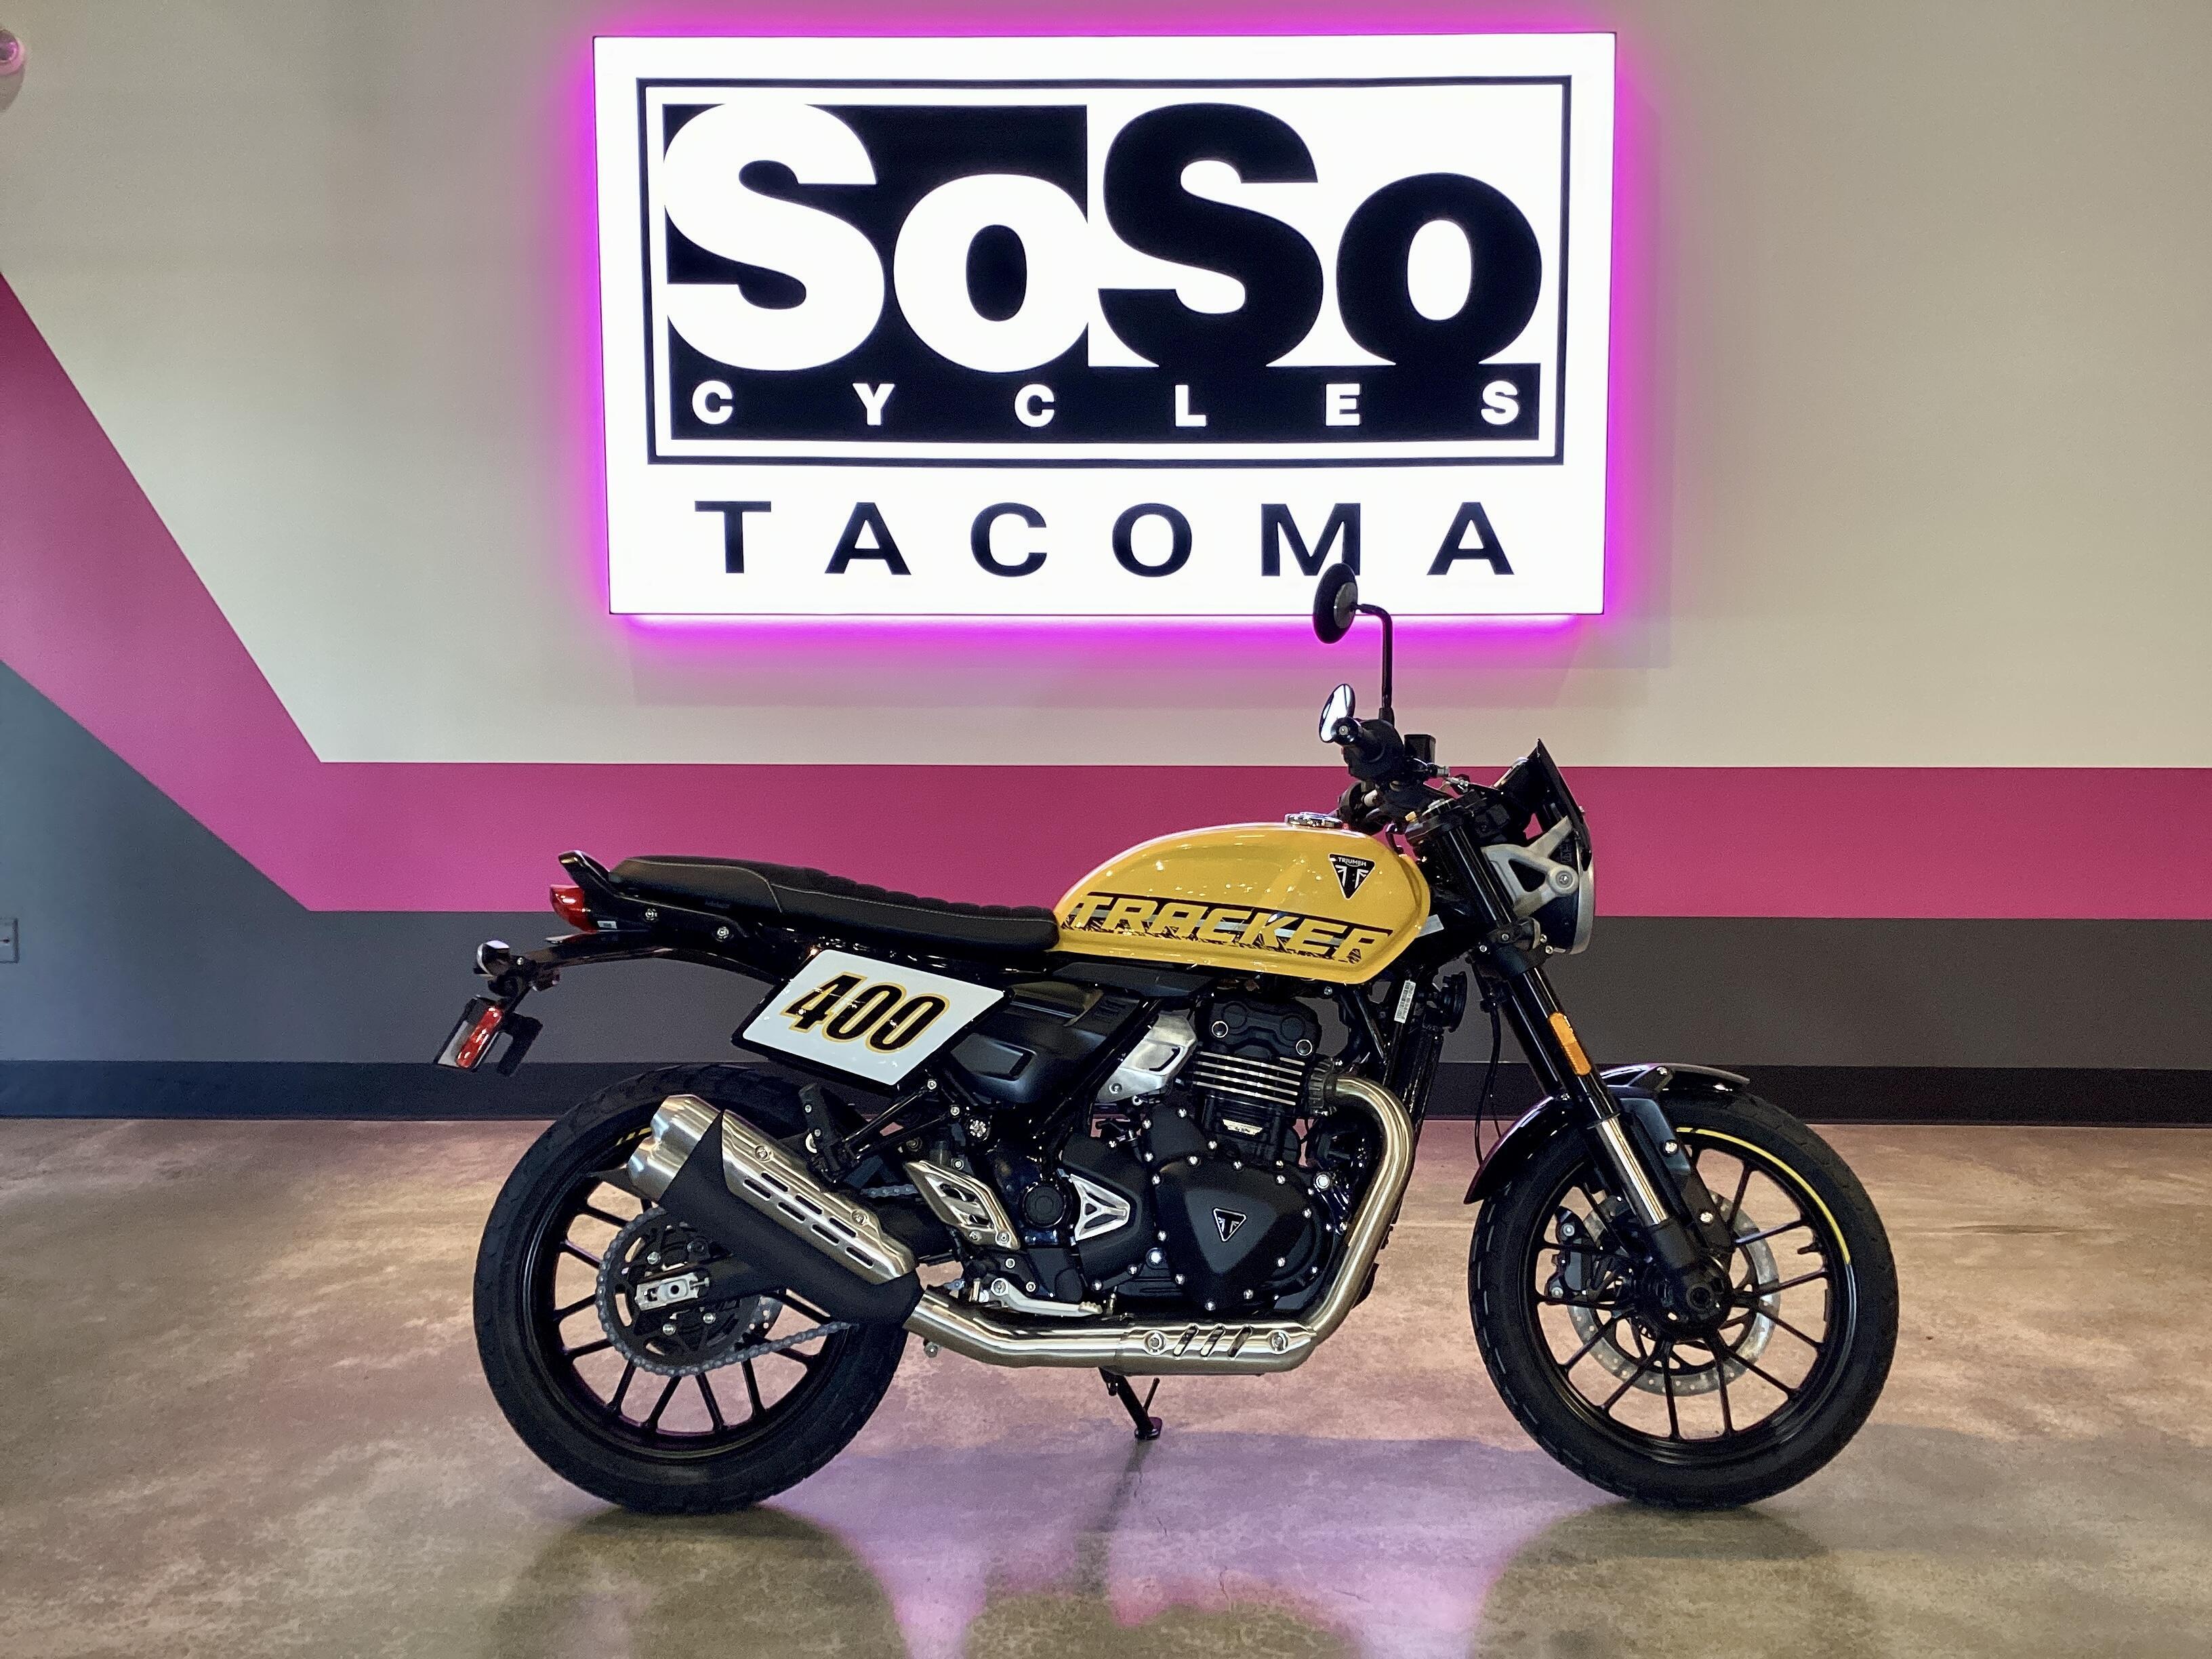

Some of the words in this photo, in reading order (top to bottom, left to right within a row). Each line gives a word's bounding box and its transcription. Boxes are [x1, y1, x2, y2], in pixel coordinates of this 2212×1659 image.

[661, 102, 1542, 373] SoSo
[692, 380, 1520, 428] CYCLES
[695, 501, 1515, 577] TACOMA
[1337, 857, 1367, 867] TRIUMPH
[1072, 894, 1390, 964] TRACKER
[780, 971, 949, 1054] 400
